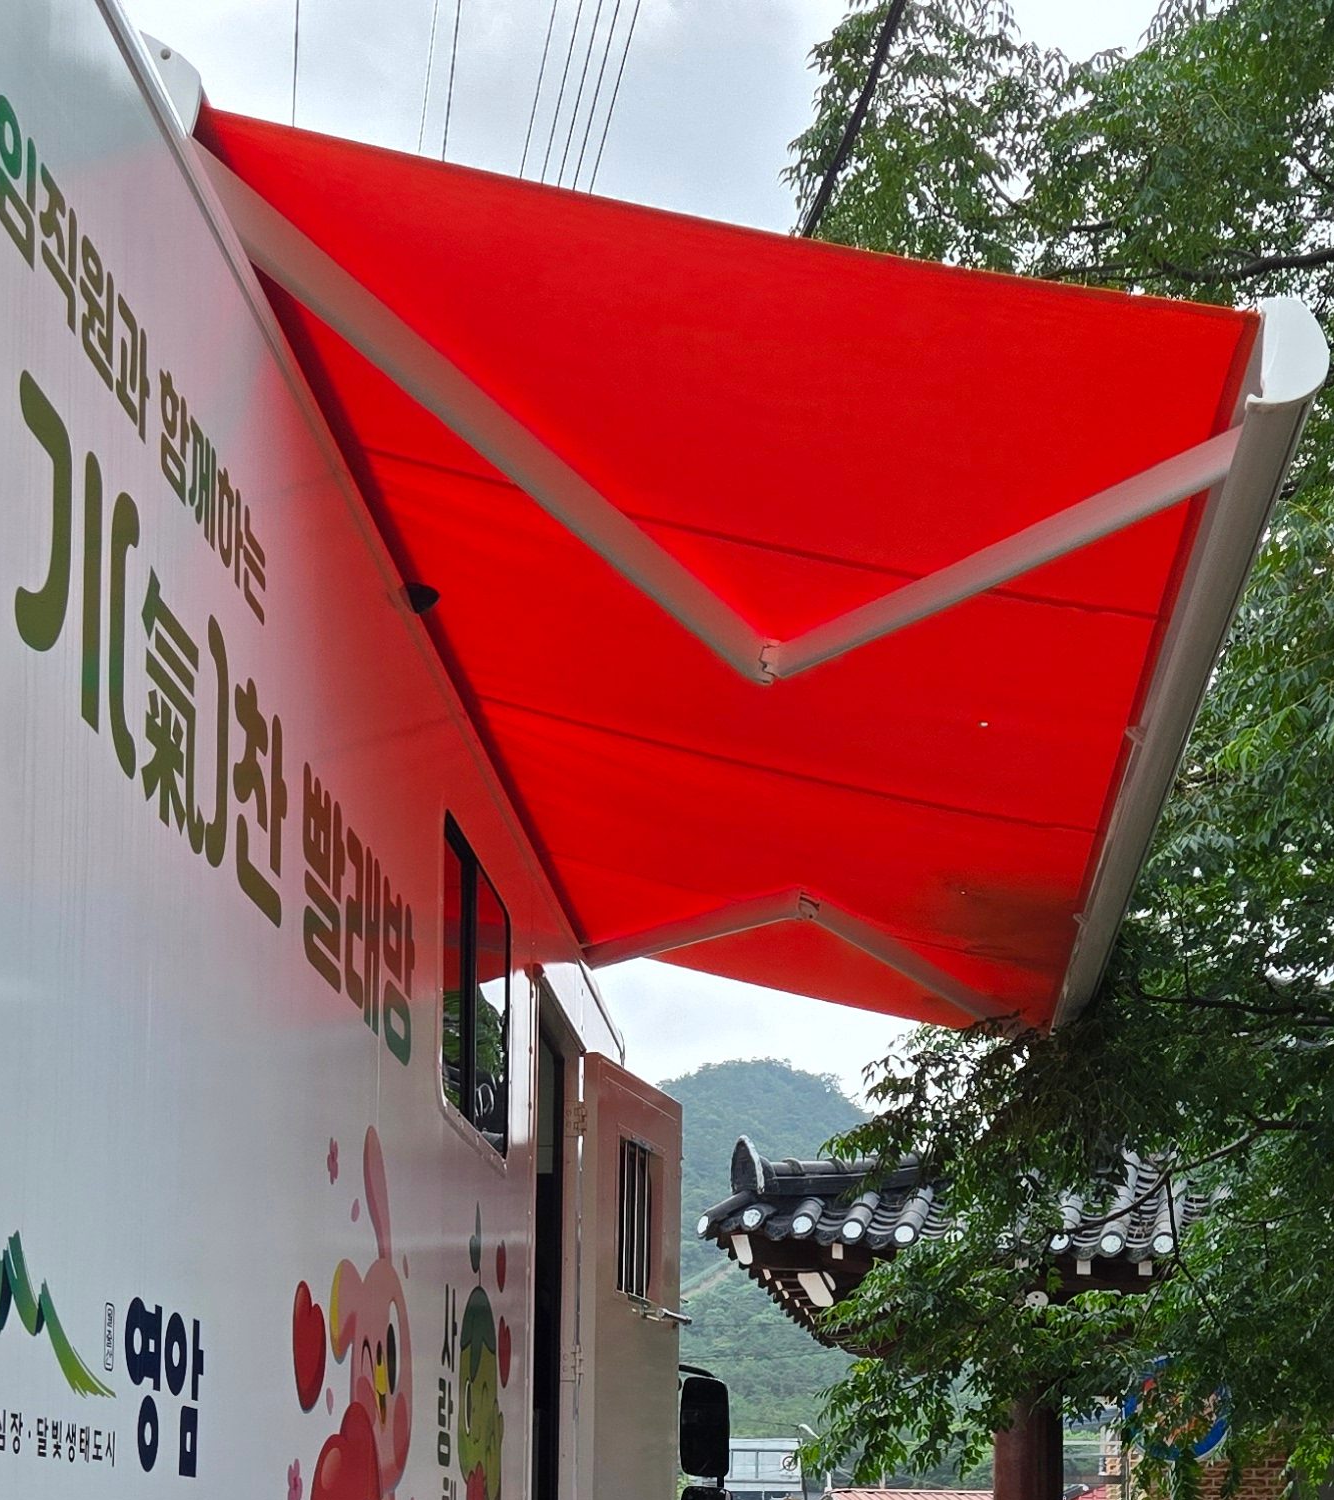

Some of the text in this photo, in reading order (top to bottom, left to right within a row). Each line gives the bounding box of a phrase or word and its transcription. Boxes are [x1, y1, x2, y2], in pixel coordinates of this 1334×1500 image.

[159, 369, 266, 626] 함께하는
[302, 761, 415, 1067] 빨래방
[124, 1296, 204, 1478] 영암
